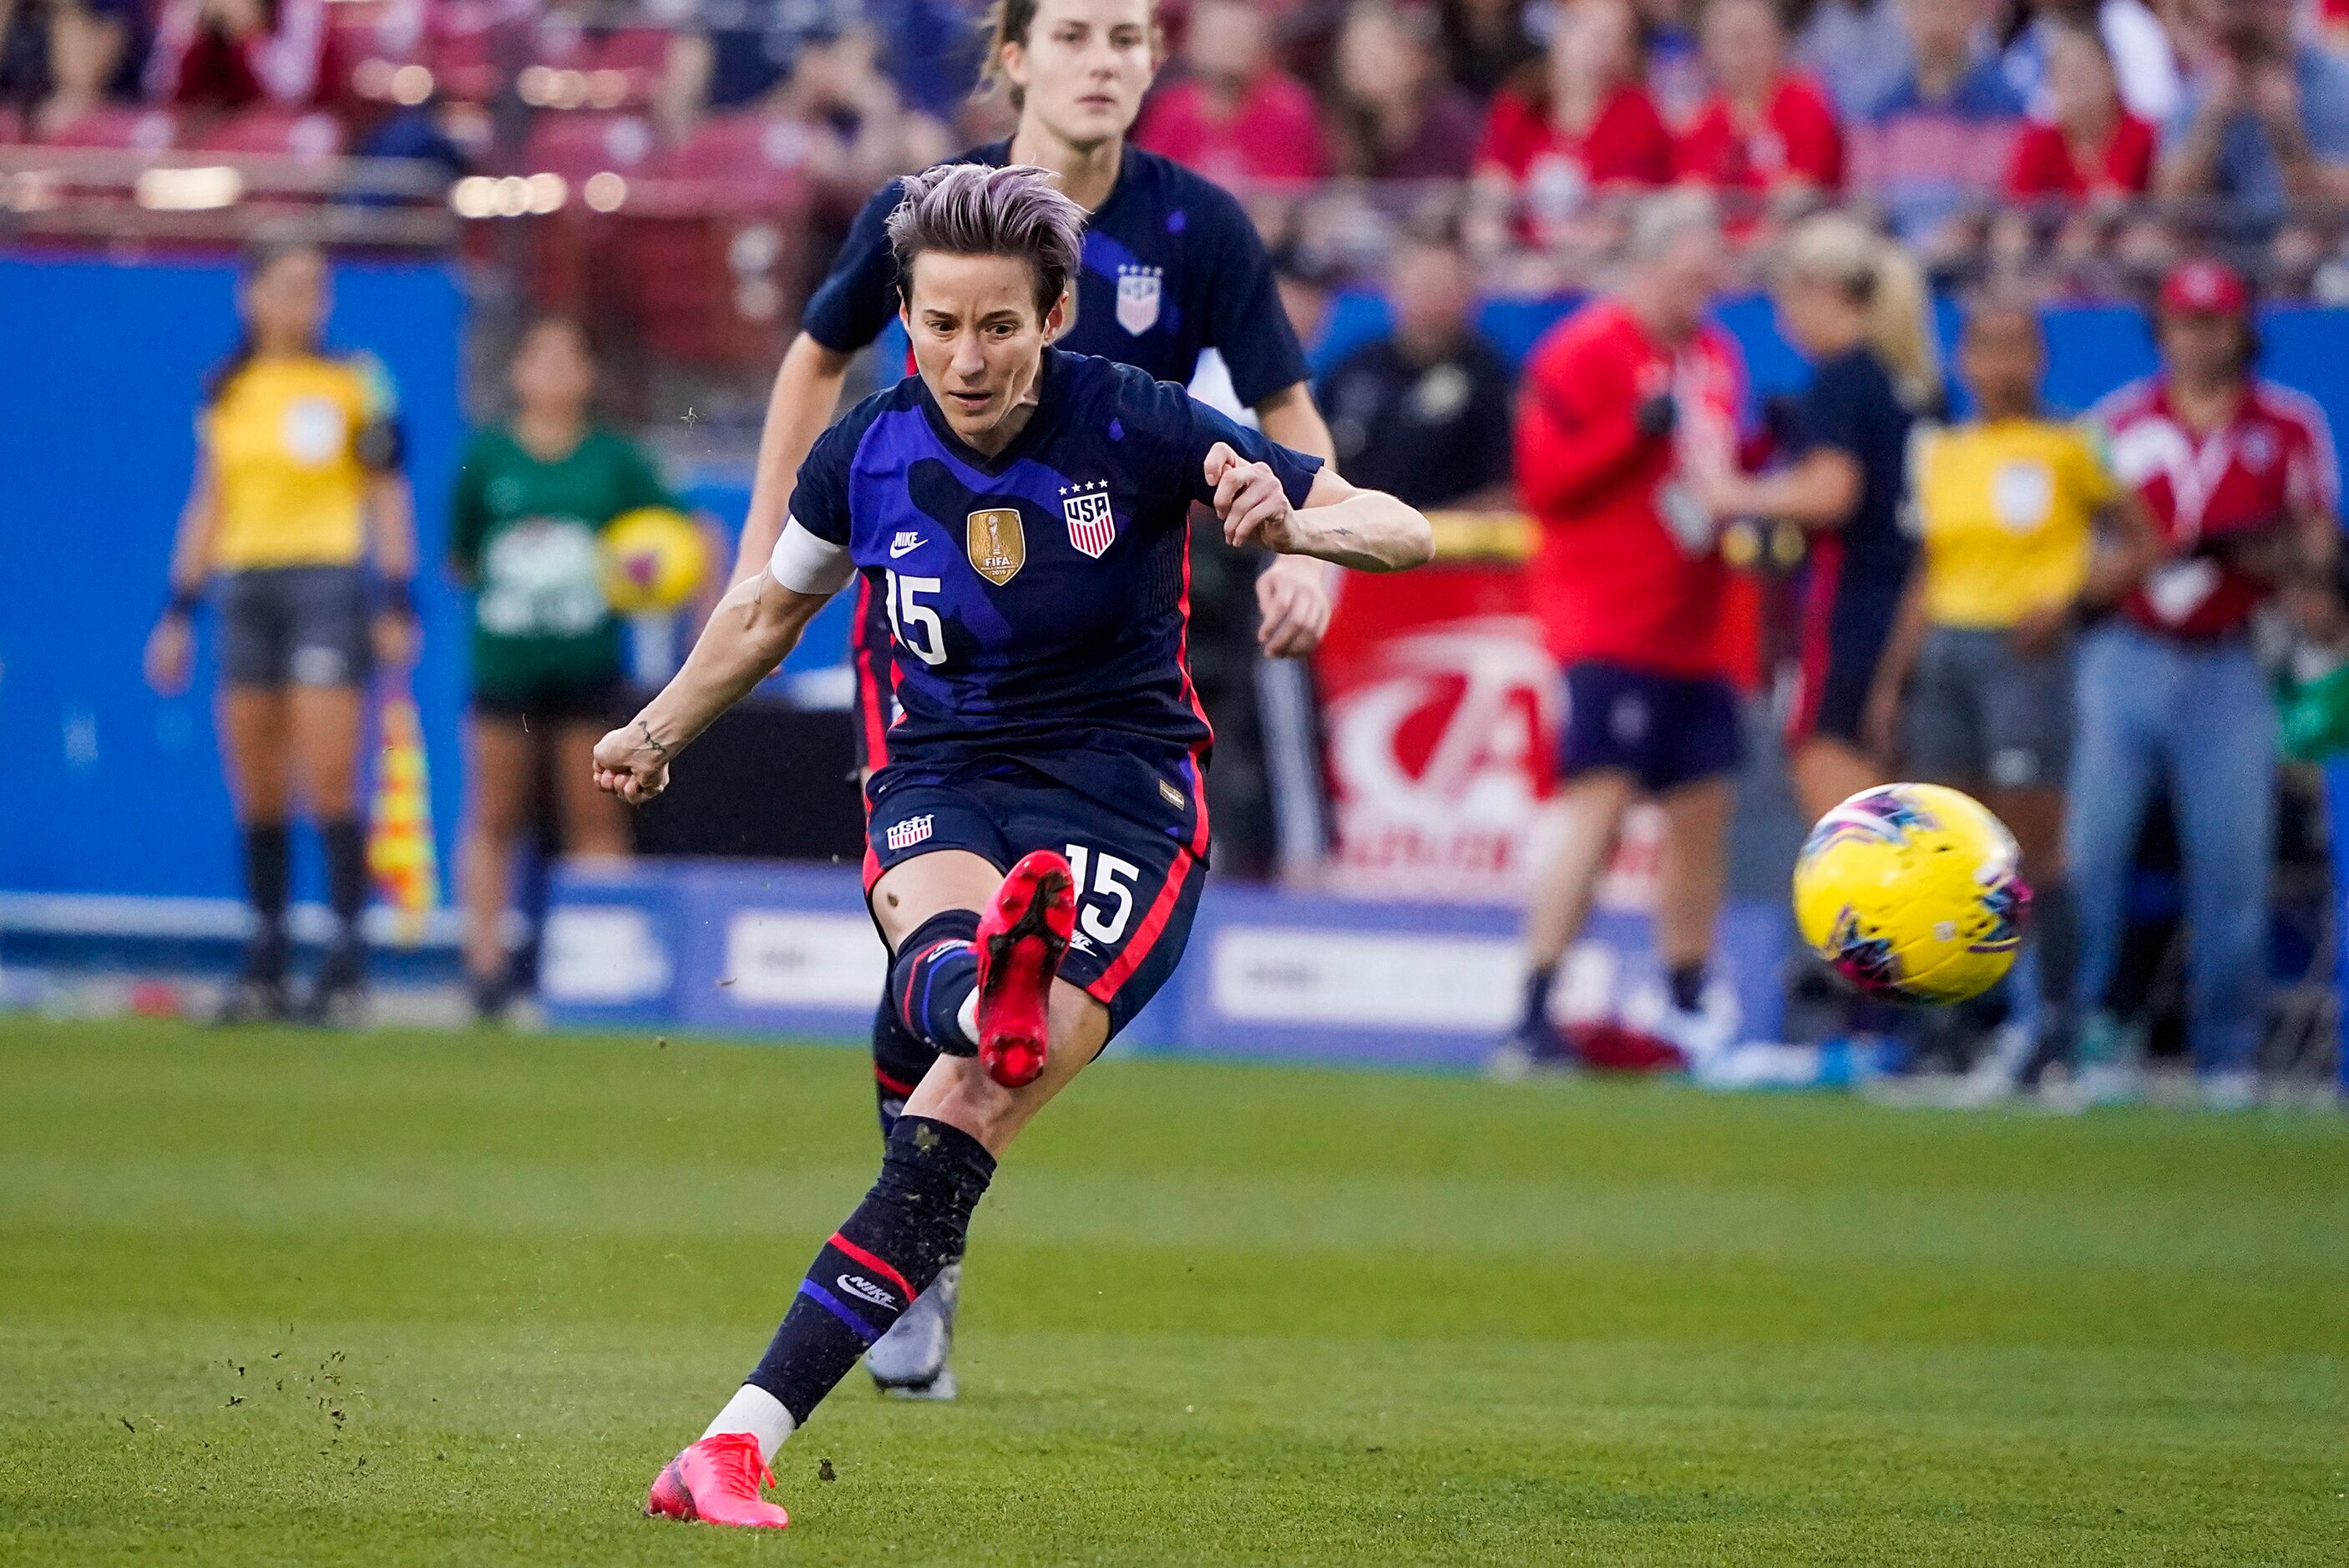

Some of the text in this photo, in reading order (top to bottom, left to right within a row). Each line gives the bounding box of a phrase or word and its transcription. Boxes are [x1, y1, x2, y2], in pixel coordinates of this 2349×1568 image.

[1066, 496, 1107, 523] USA
[894, 532, 918, 547] NIKE
[985, 556, 1010, 567] FIFA
[885, 567, 947, 665] 15
[891, 820, 928, 836] USA
[1066, 843, 1140, 944] 15
[849, 1277, 895, 1303] NIKE
